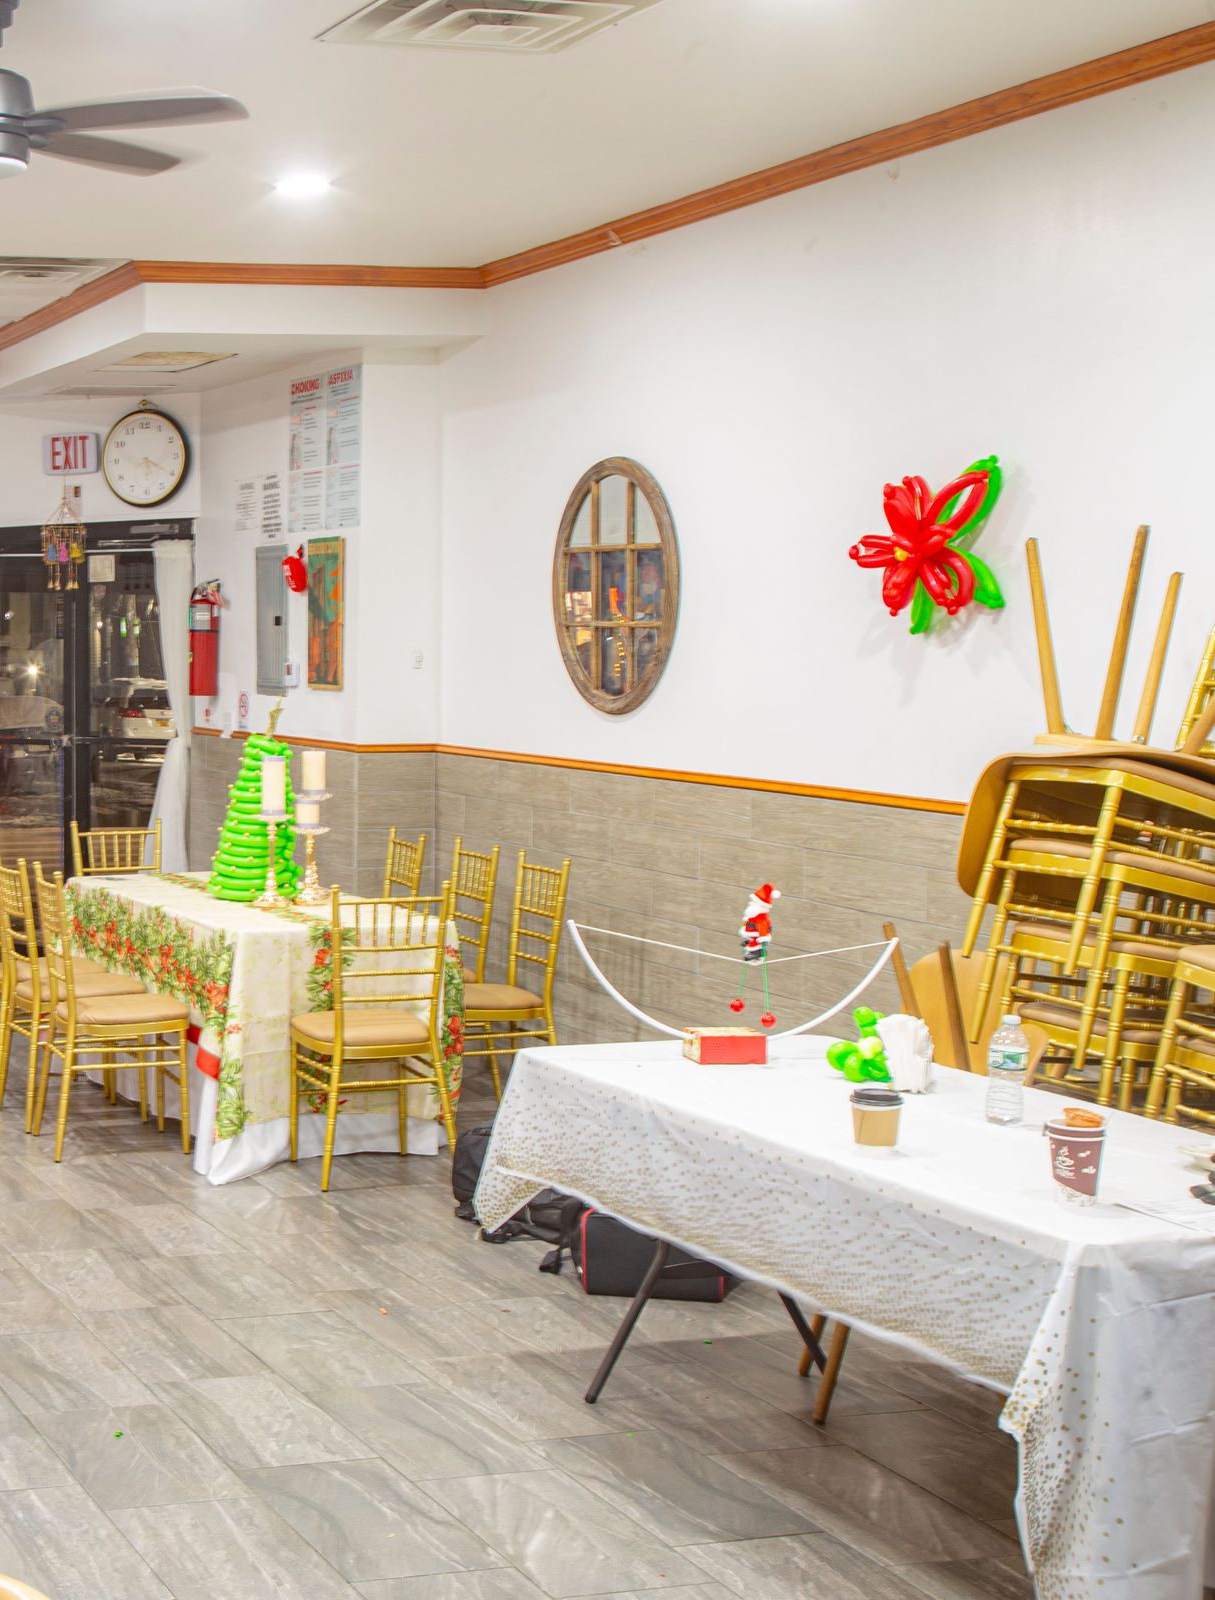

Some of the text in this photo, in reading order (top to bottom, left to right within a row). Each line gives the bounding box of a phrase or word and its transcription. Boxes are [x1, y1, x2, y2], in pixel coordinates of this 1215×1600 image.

[291, 378, 320, 395] CHOKING
[51, 435, 89, 471] EXIT
[114, 441, 126, 449] 10
